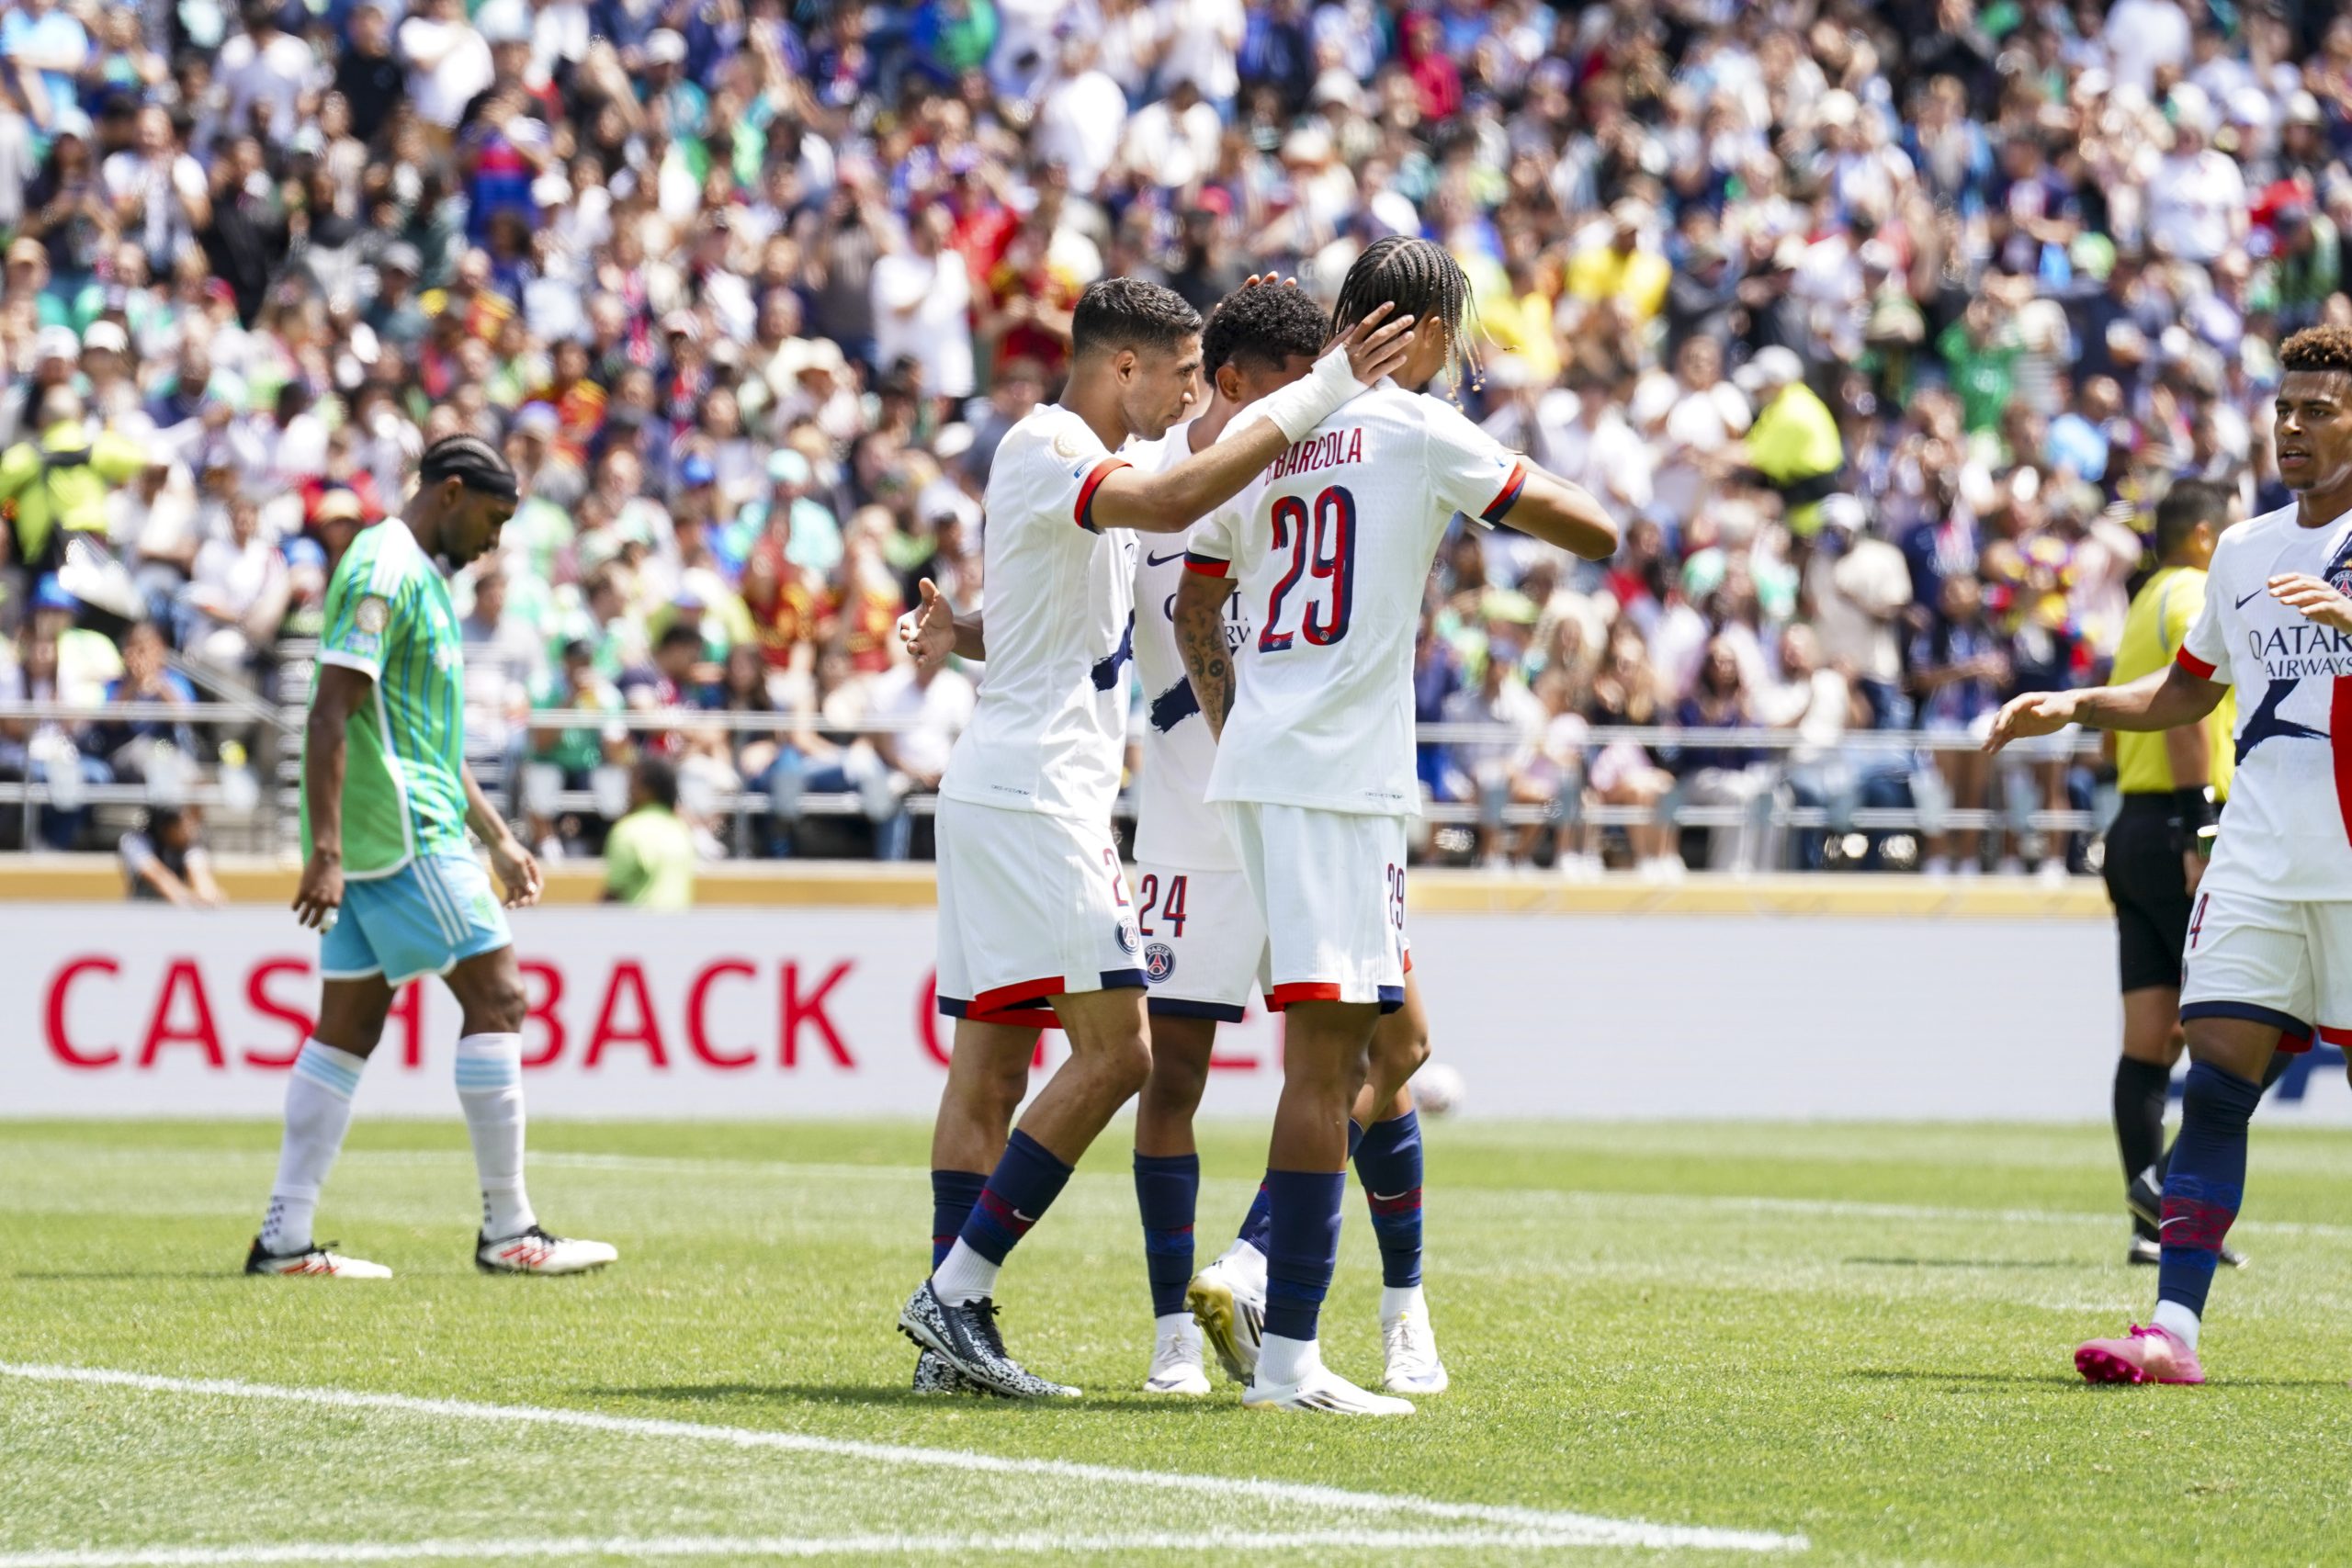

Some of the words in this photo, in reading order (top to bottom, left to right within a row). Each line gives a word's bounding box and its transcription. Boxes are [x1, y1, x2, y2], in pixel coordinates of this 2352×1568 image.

[1259, 485, 1356, 653] 29
[2249, 625, 2352, 664] QATAR
[1102, 848, 1129, 907] 2
[1139, 874, 1187, 938] 24
[1387, 863, 1404, 931] 29
[520, 958, 856, 1068] BACK
